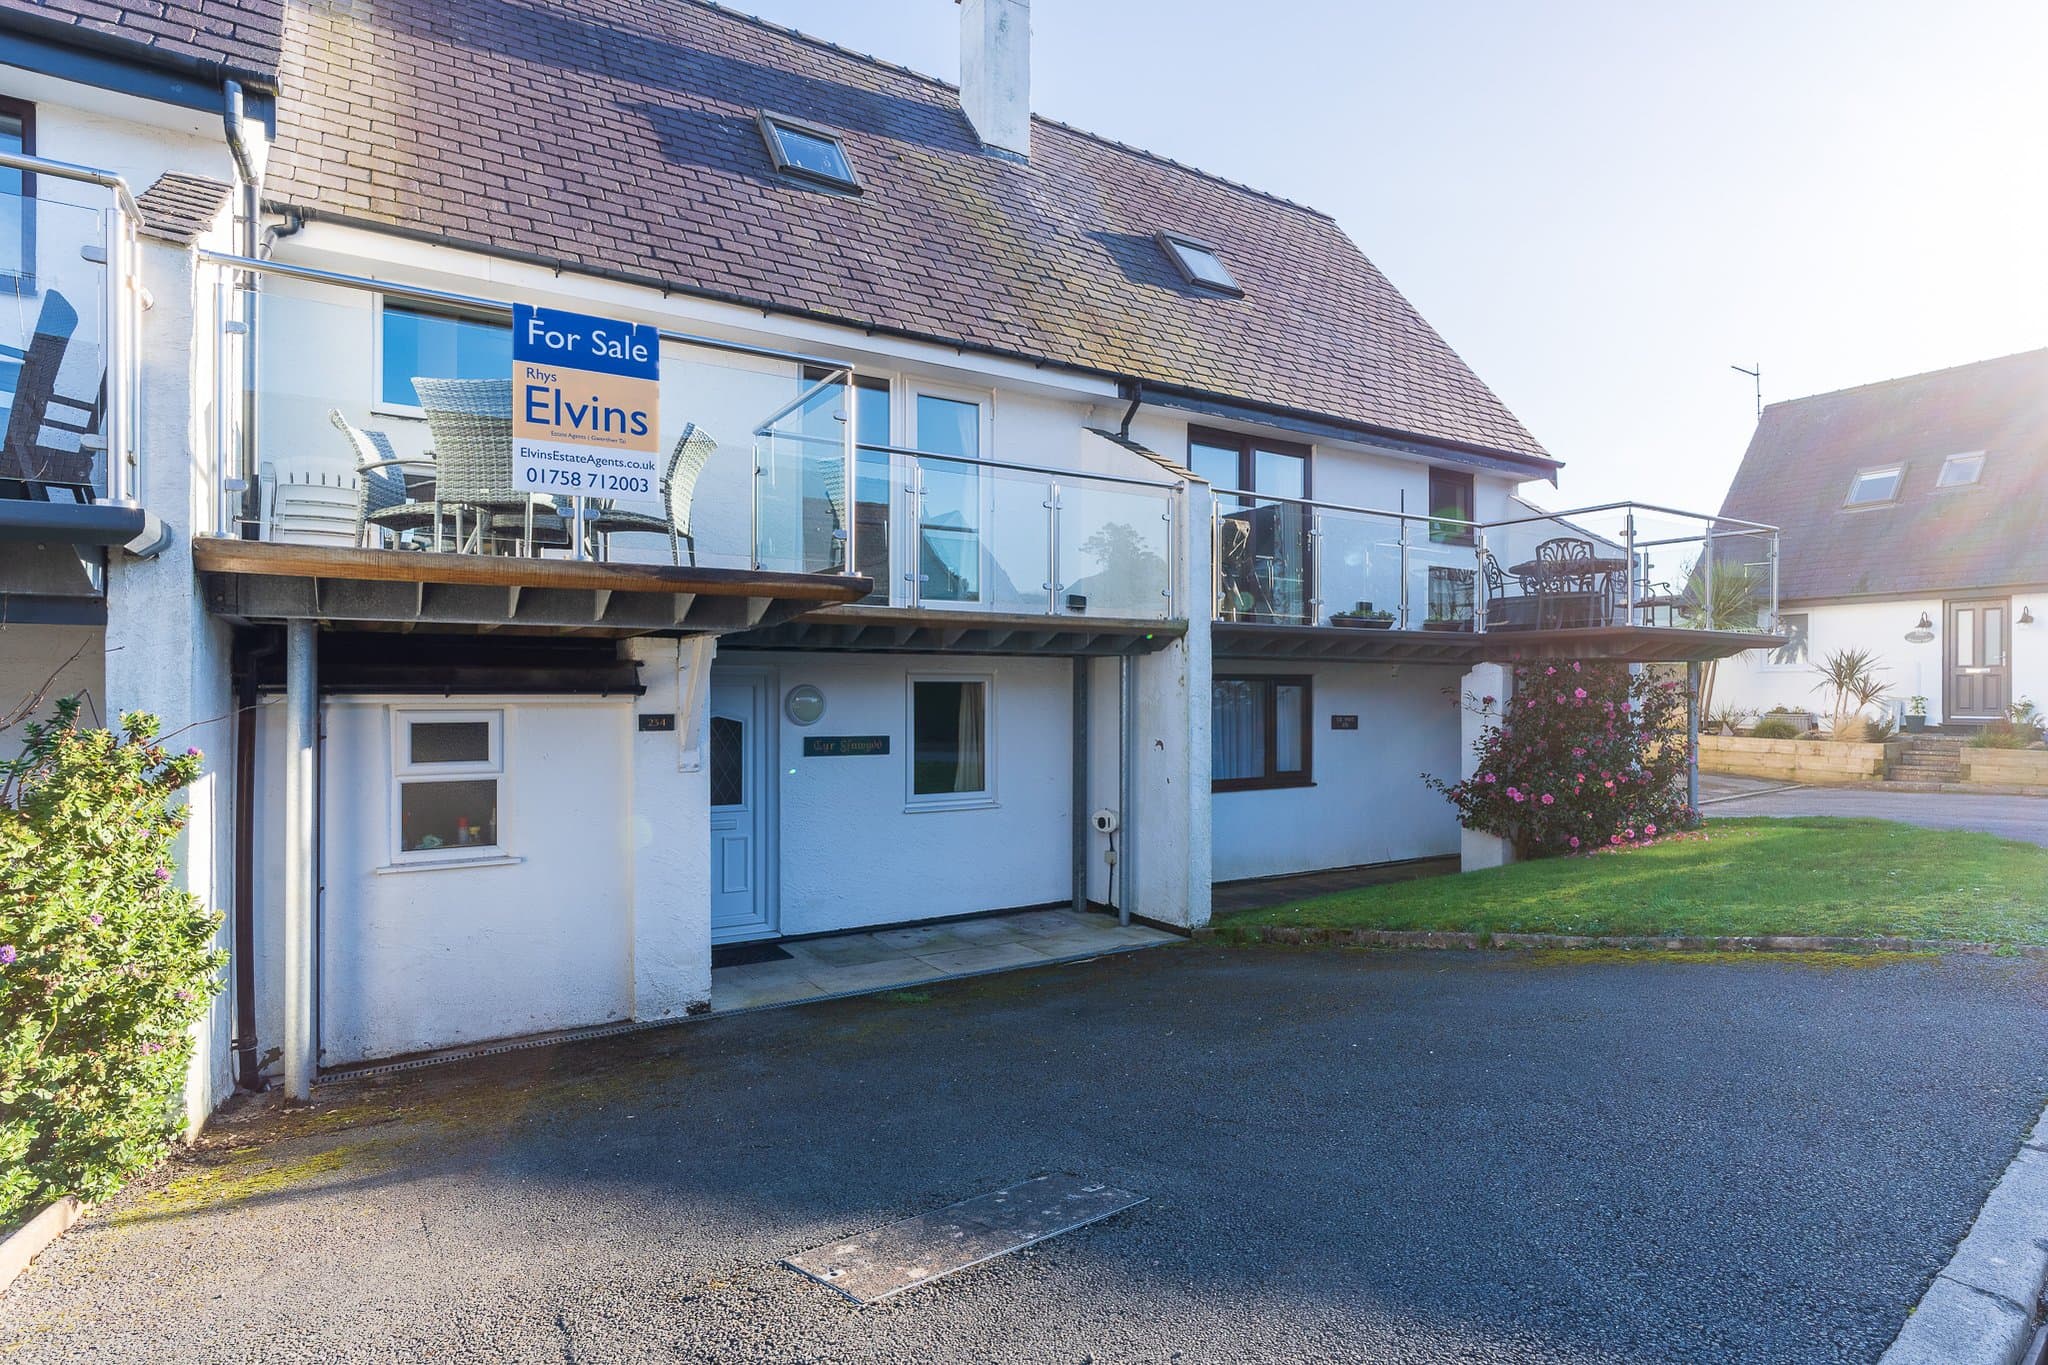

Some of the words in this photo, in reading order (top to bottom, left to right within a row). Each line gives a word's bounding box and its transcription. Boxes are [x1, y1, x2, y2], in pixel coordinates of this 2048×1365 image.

[528, 319, 581, 351] For
[591, 330, 648, 363] Sale
[526, 367, 557, 384] Rhys
[526, 384, 648, 436] Elvins
[520, 447, 655, 471] ElvinsEstateAgents.co.uk
[526, 467, 581, 487] 01758
[588, 473, 649, 492] 712003
